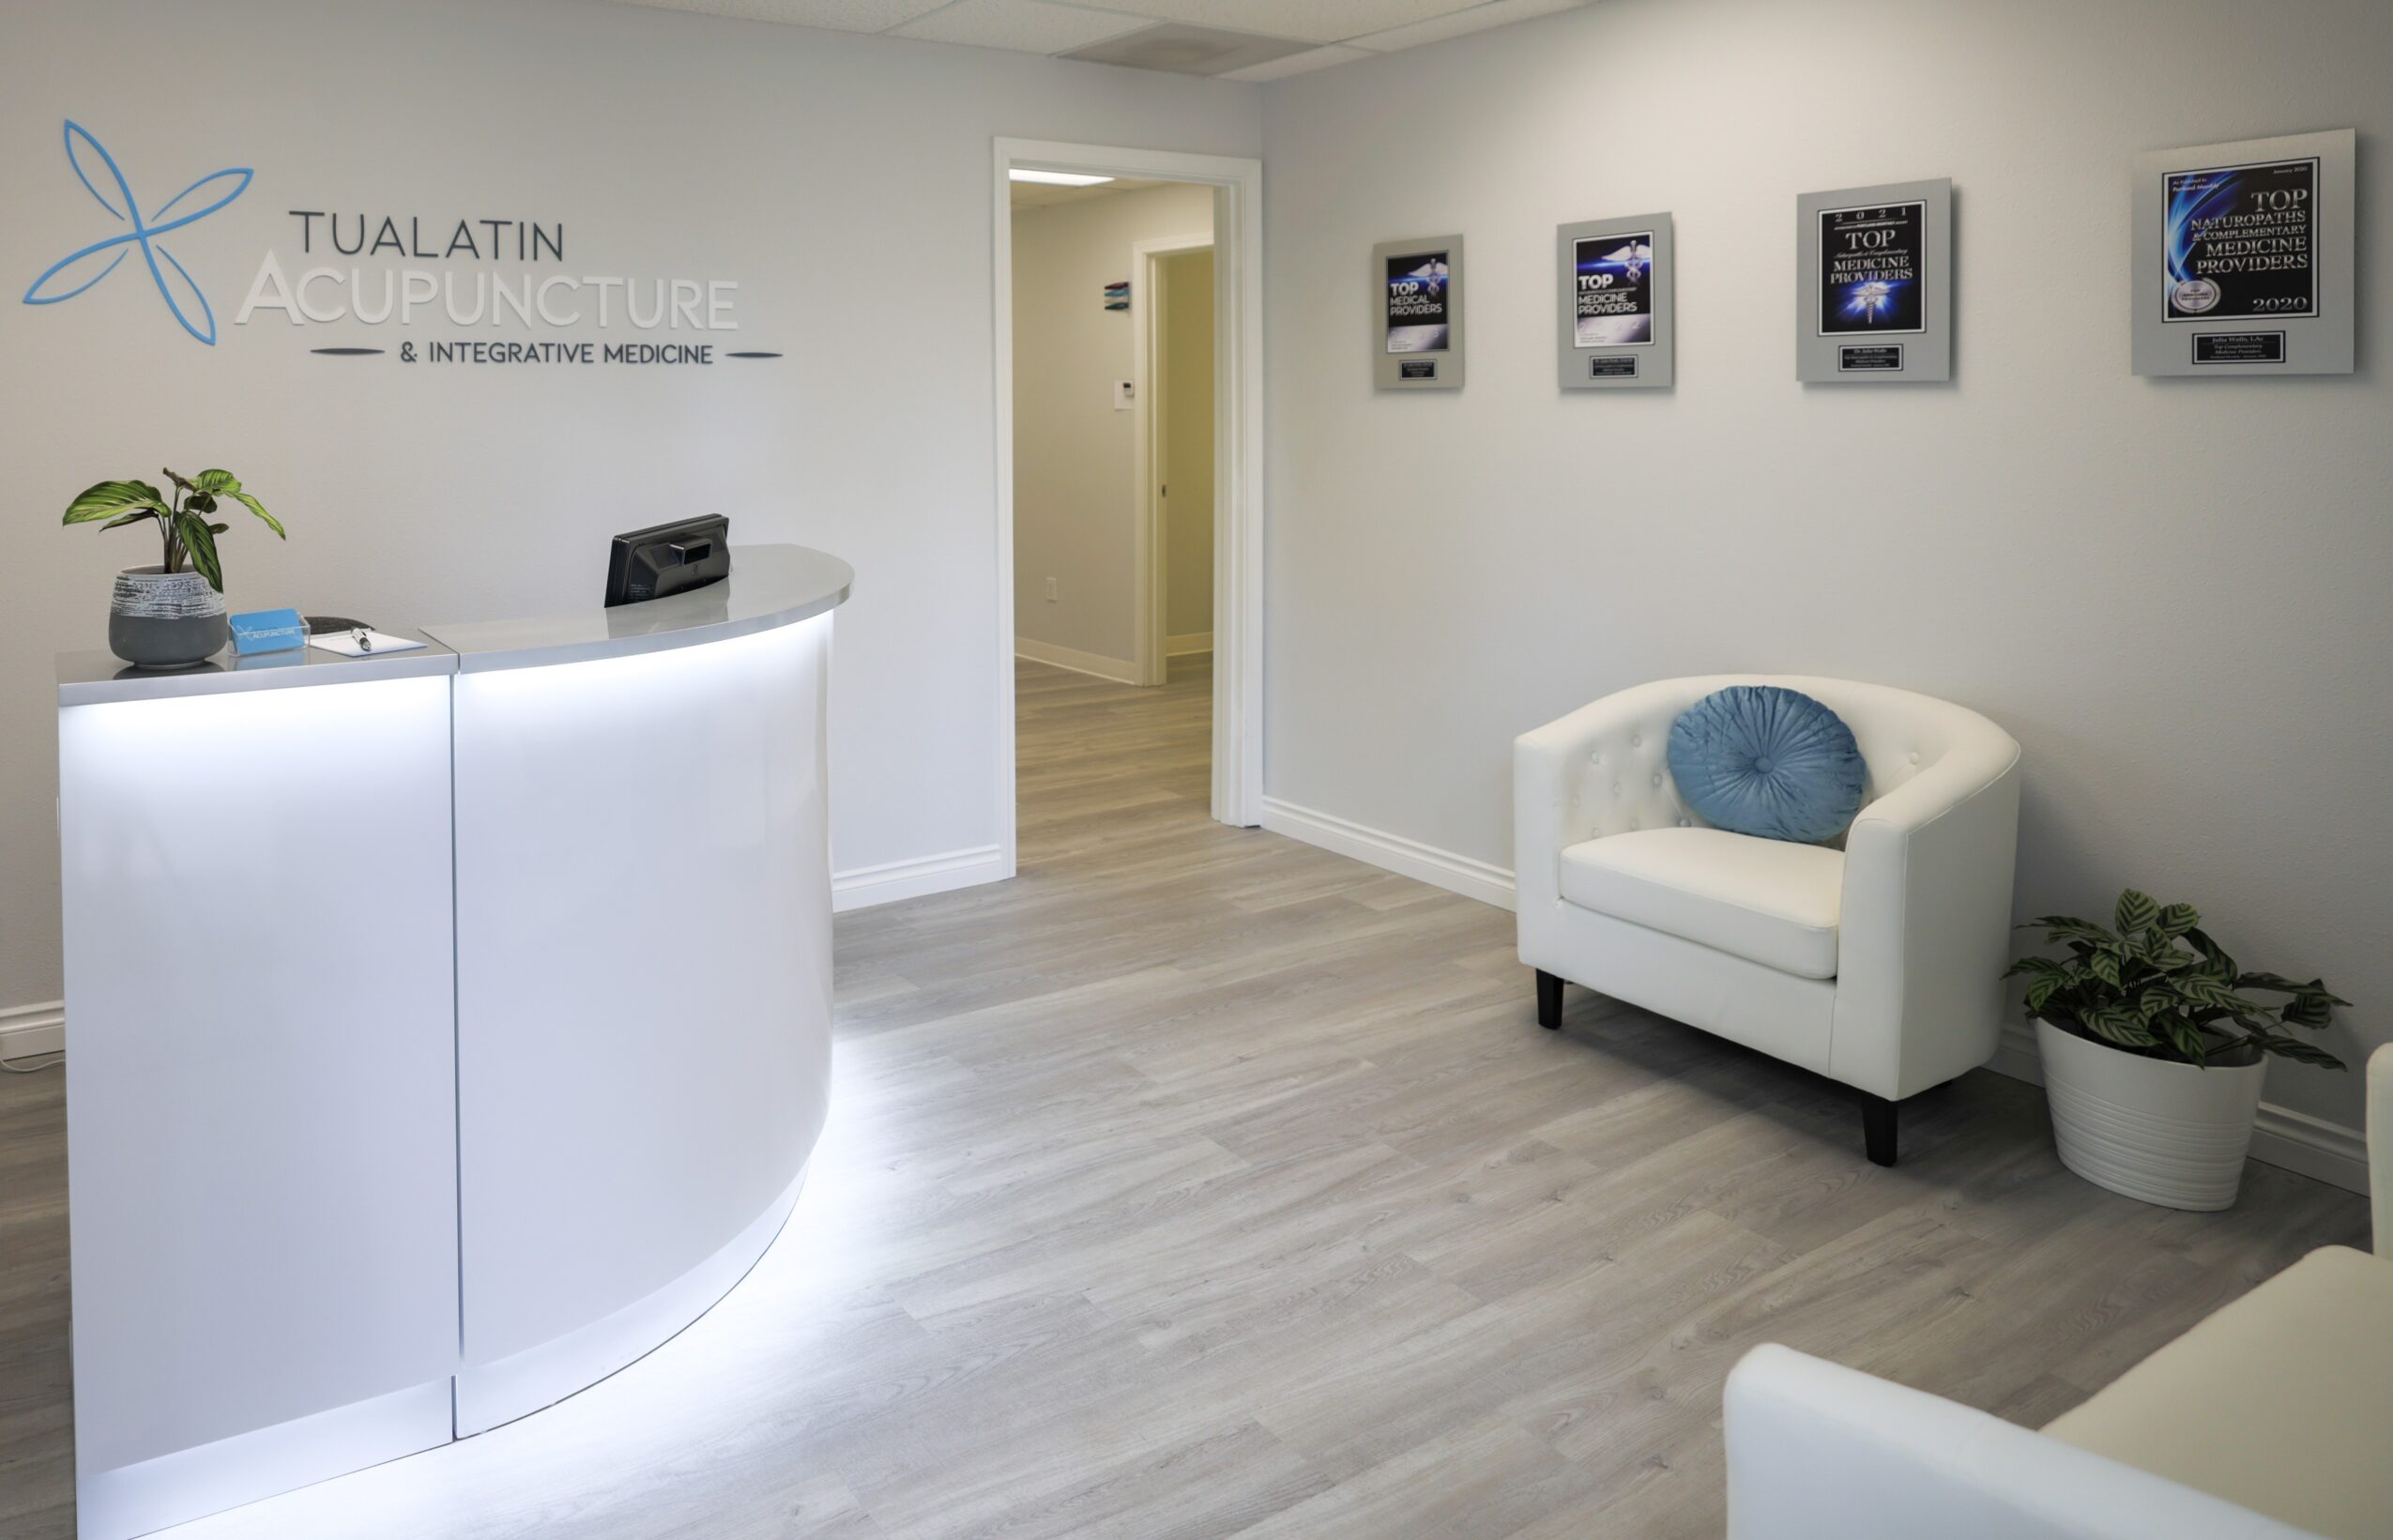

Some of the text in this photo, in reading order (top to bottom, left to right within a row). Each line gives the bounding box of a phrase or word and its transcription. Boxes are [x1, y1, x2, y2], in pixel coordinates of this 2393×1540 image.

[2251, 188, 2309, 212] TOP
[1836, 207, 1907, 222] 2021
[2190, 209, 2307, 231] NATUROPATHS
[288, 210, 564, 262] TUALATIN
[1845, 229, 1896, 250] TOP
[2192, 224, 2307, 241] & COMPLEMENTARY
[2206, 236, 2308, 257] MEDICINE
[1833, 255, 1910, 272] MEDICINE
[2196, 253, 2309, 274] PROVIDERS
[1578, 274, 1613, 290] TOP
[1830, 267, 1913, 284] PROVIDERS
[233, 250, 740, 330] ACUPUNCTURE
[1390, 282, 1419, 297] TOP
[1390, 295, 1429, 306] MEDICAL
[1578, 292, 1628, 305] MEDICINE
[2252, 297, 2308, 312] 2020
[1390, 303, 1442, 316] PROVIDERS
[1578, 302, 1638, 315] PROVIDERS
[400, 342, 713, 364] & INTEGRATIVE MEDICINE
